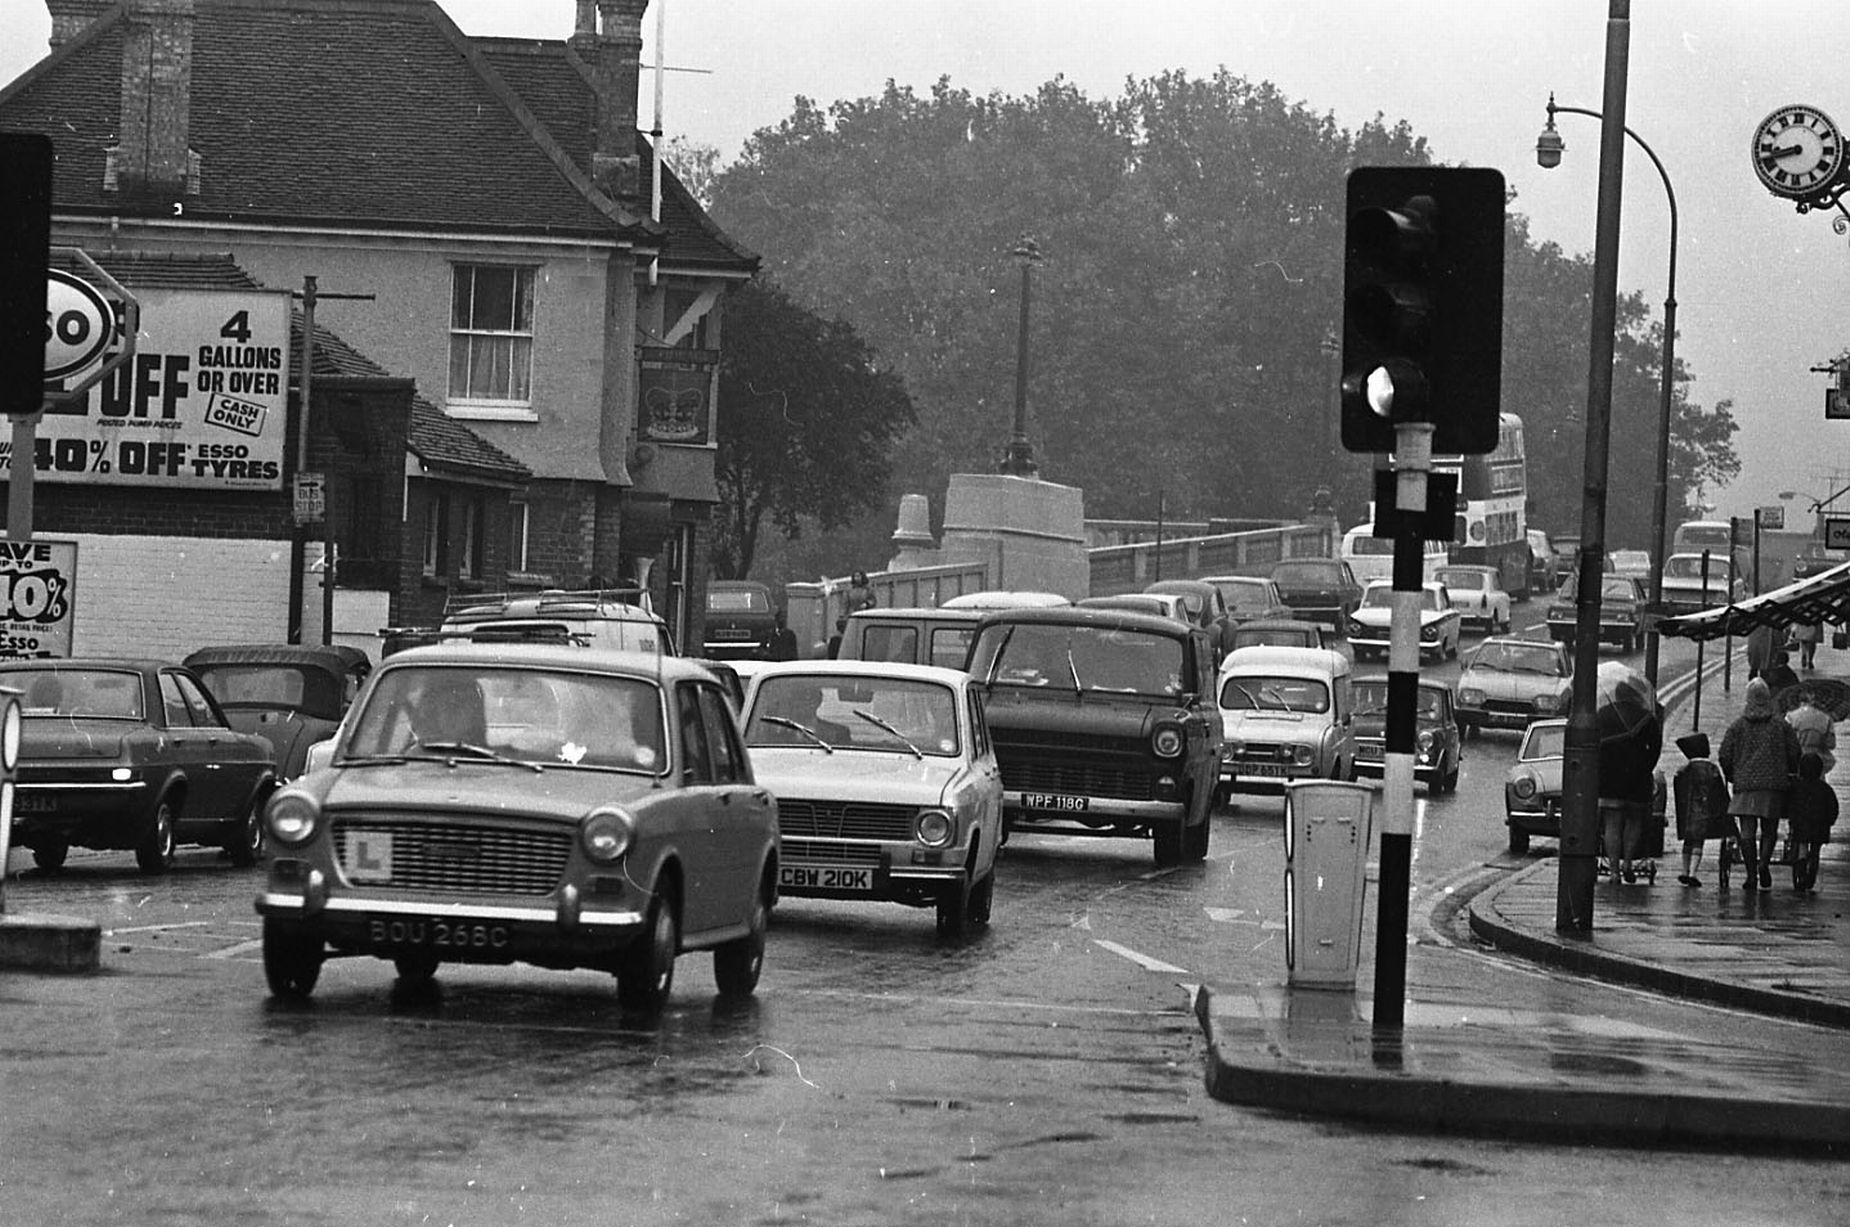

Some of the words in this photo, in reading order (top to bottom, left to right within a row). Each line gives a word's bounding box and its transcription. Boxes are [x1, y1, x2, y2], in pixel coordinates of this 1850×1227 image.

[220, 310, 252, 343] 4
[199, 346, 281, 369] GALLONS
[101, 352, 191, 419] OFF
[198, 370, 224, 393] OR
[229, 372, 279, 395] OVER
[213, 409, 256, 430] ONLY
[220, 399, 260, 419] CASH
[198, 444, 249, 459] ESSO
[191, 459, 280, 480] TYRES
[298, 488, 319, 499] BUS
[295, 500, 323, 512] STOP
[1026, 792, 1053, 808] WPF
[1056, 795, 1084, 810] 118G
[357, 841, 381, 870] L
[781, 868, 819, 887] CBW
[824, 870, 868, 889] 210K
[369, 920, 426, 944] BOU
[433, 924, 510, 948] 268C
